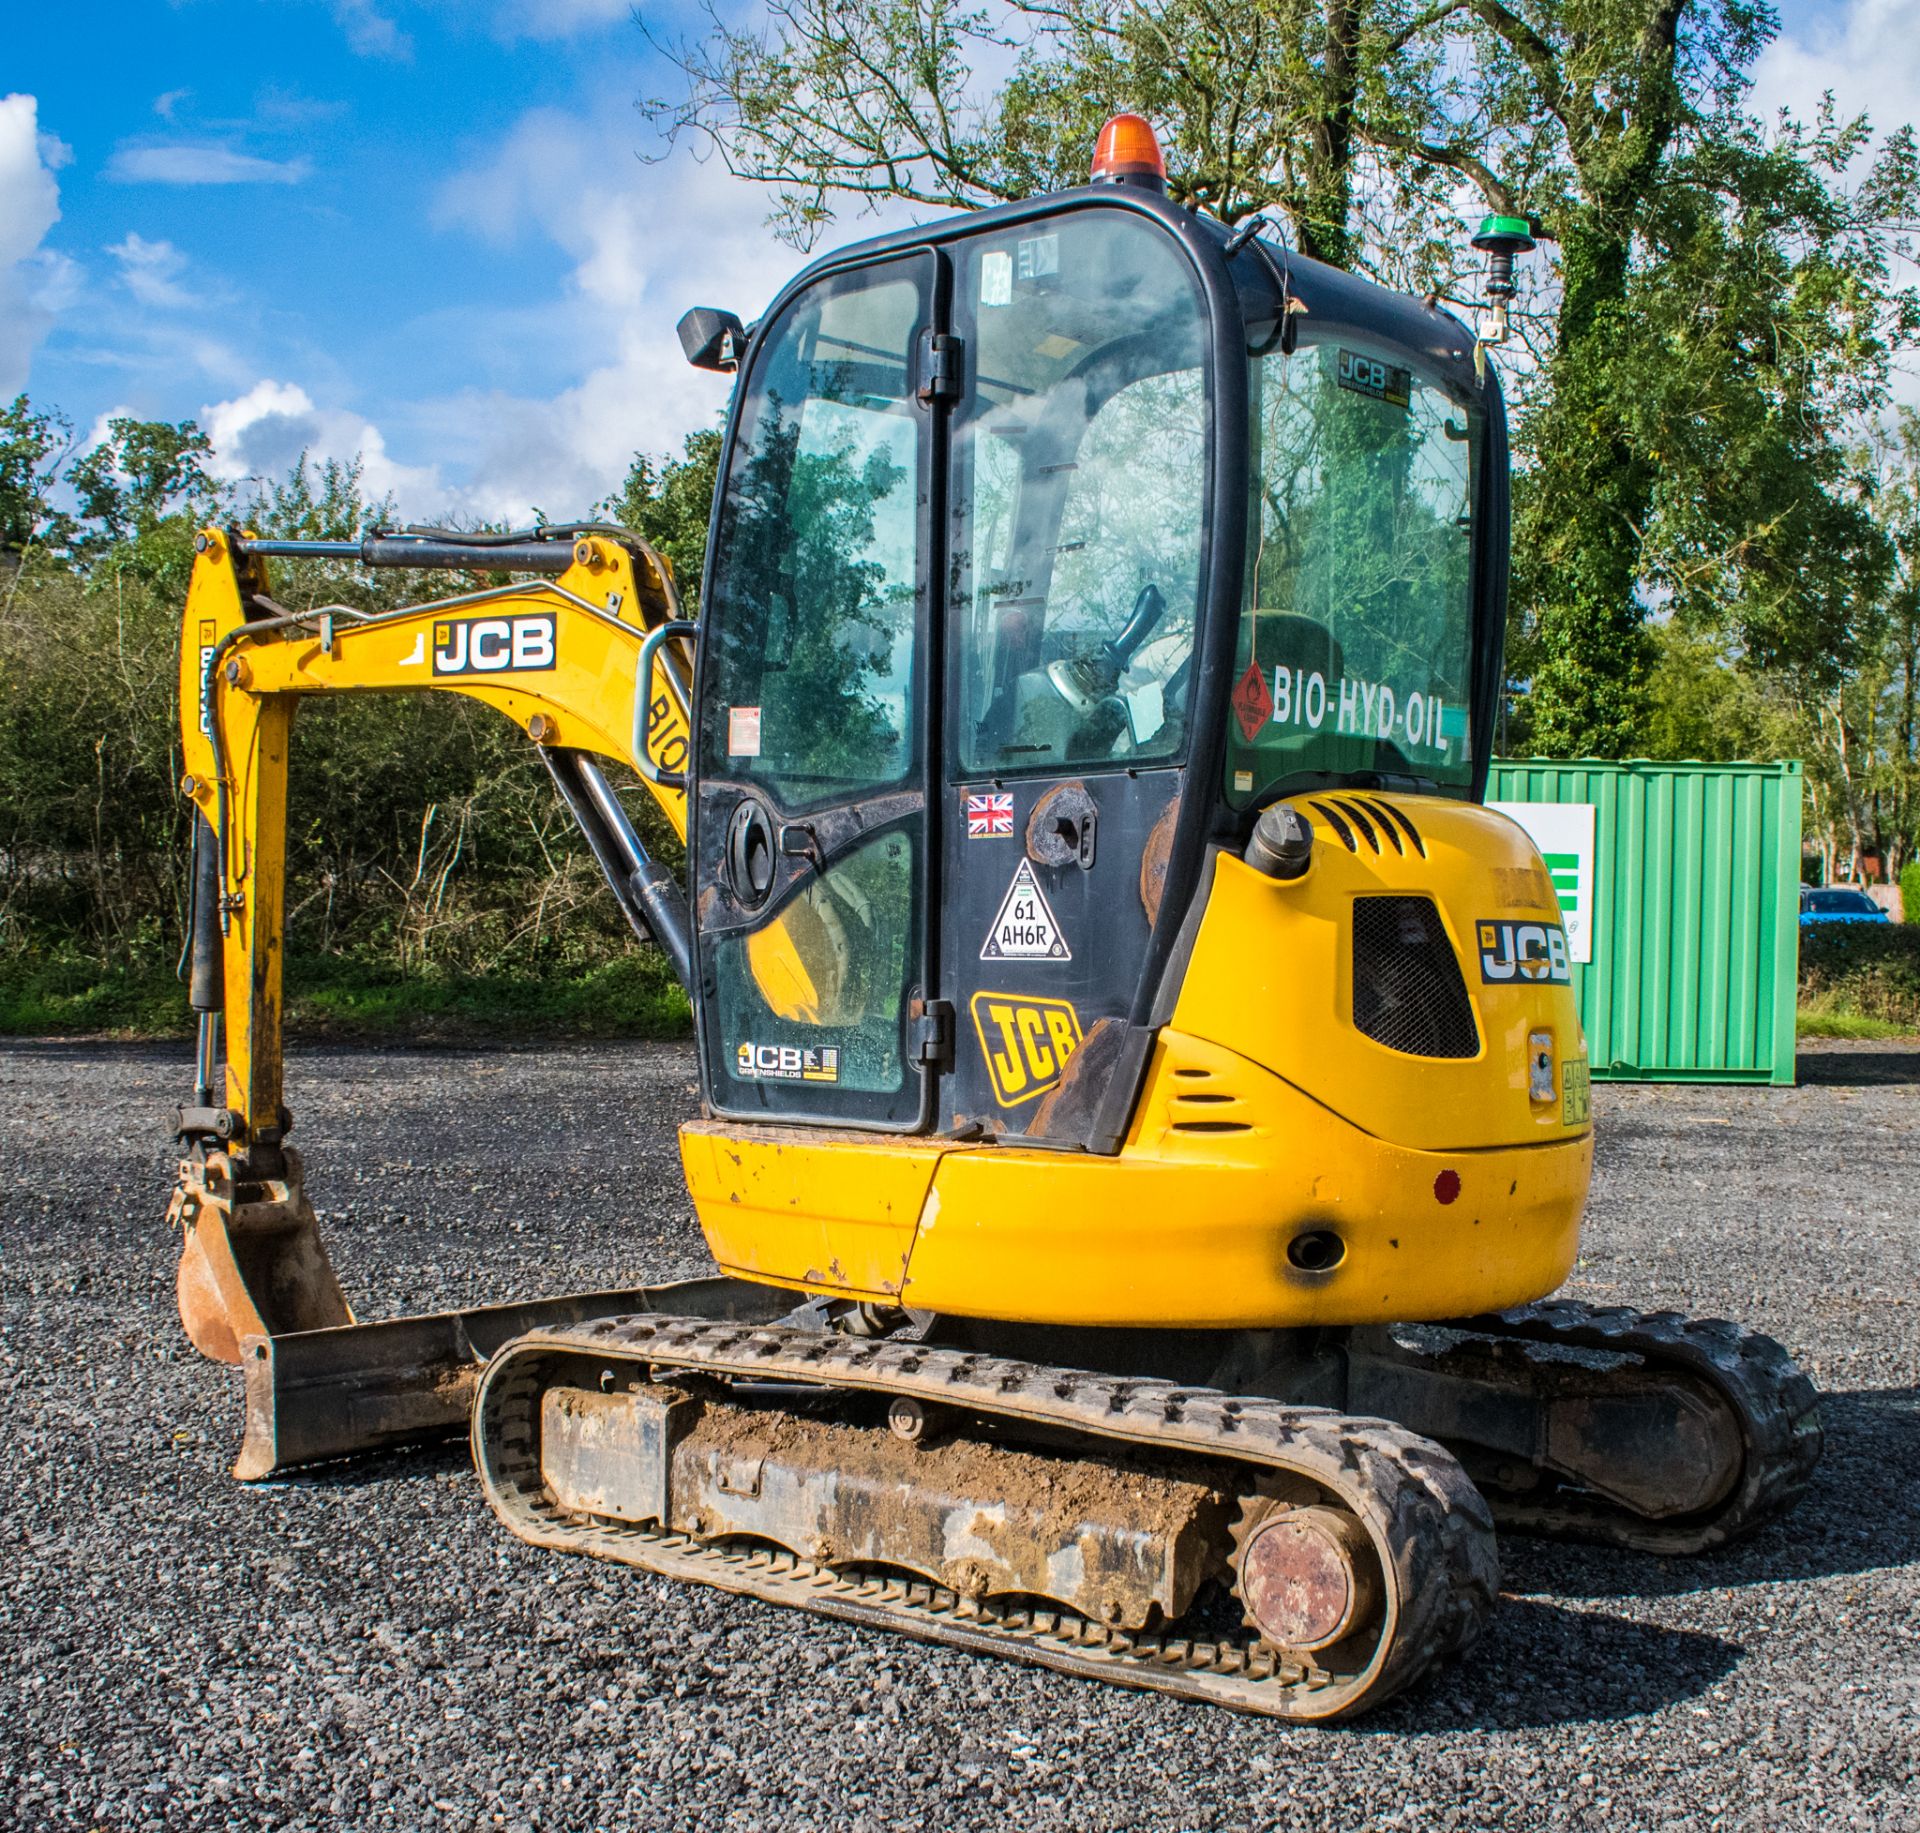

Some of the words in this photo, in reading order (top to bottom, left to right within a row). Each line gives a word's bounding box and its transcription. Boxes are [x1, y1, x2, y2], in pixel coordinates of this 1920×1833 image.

[1340, 354, 1386, 390] JCB
[436, 618, 554, 672] JCB
[1272, 665, 1448, 751] BIO-HYD-OIL
[1014, 900, 1036, 921] 61
[1002, 925, 1047, 946] AH6R
[1483, 925, 1570, 980] JCB
[738, 1042, 802, 1071] JCB
[988, 1004, 1076, 1094] JCB
